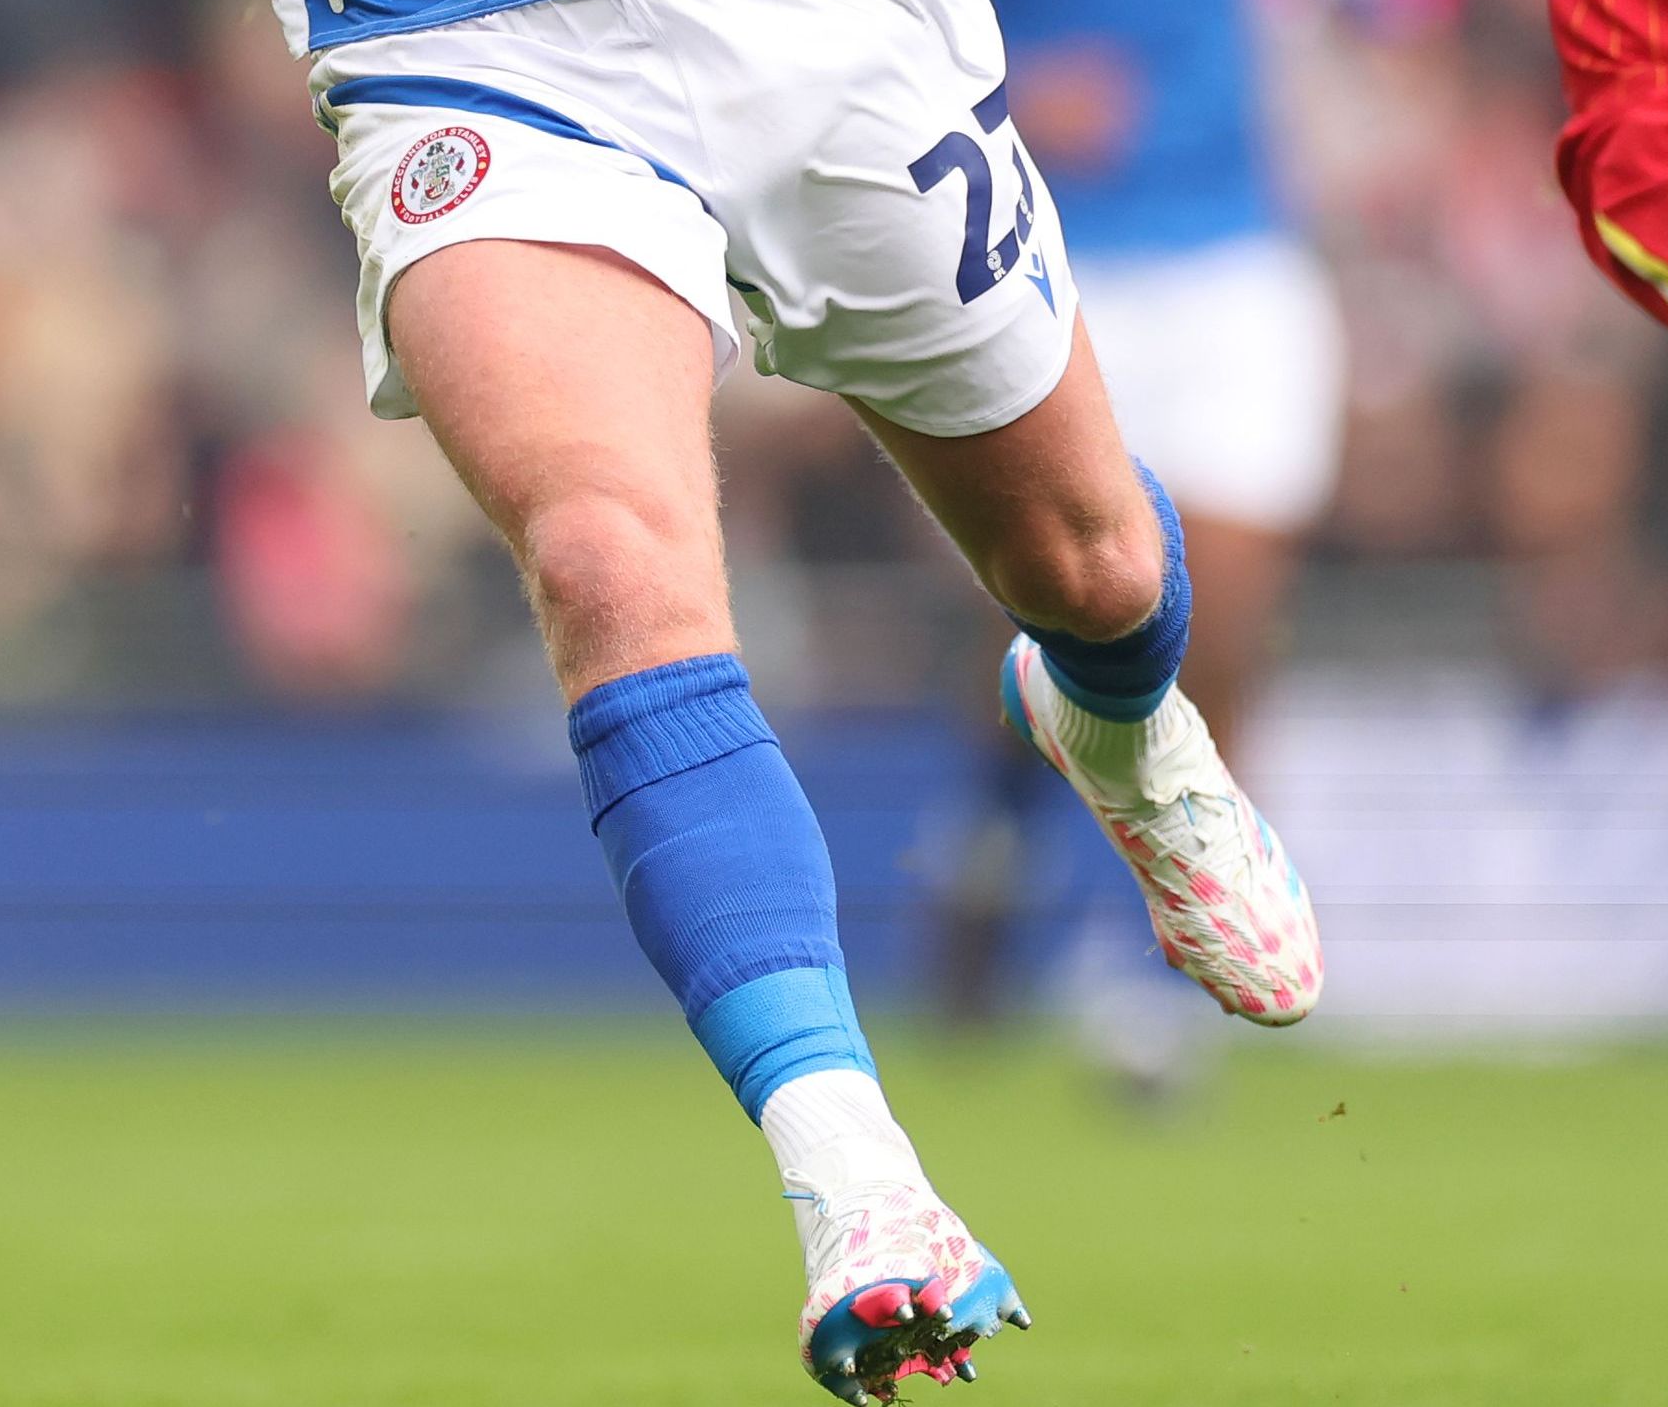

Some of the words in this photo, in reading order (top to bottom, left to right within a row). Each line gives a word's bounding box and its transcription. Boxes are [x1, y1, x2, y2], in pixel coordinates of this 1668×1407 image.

[393, 129, 446, 192] ACCRINGTON
[449, 128, 487, 158] STANLEY
[400, 208, 449, 223] FOOTBALL
[453, 176, 479, 205] CLUB
